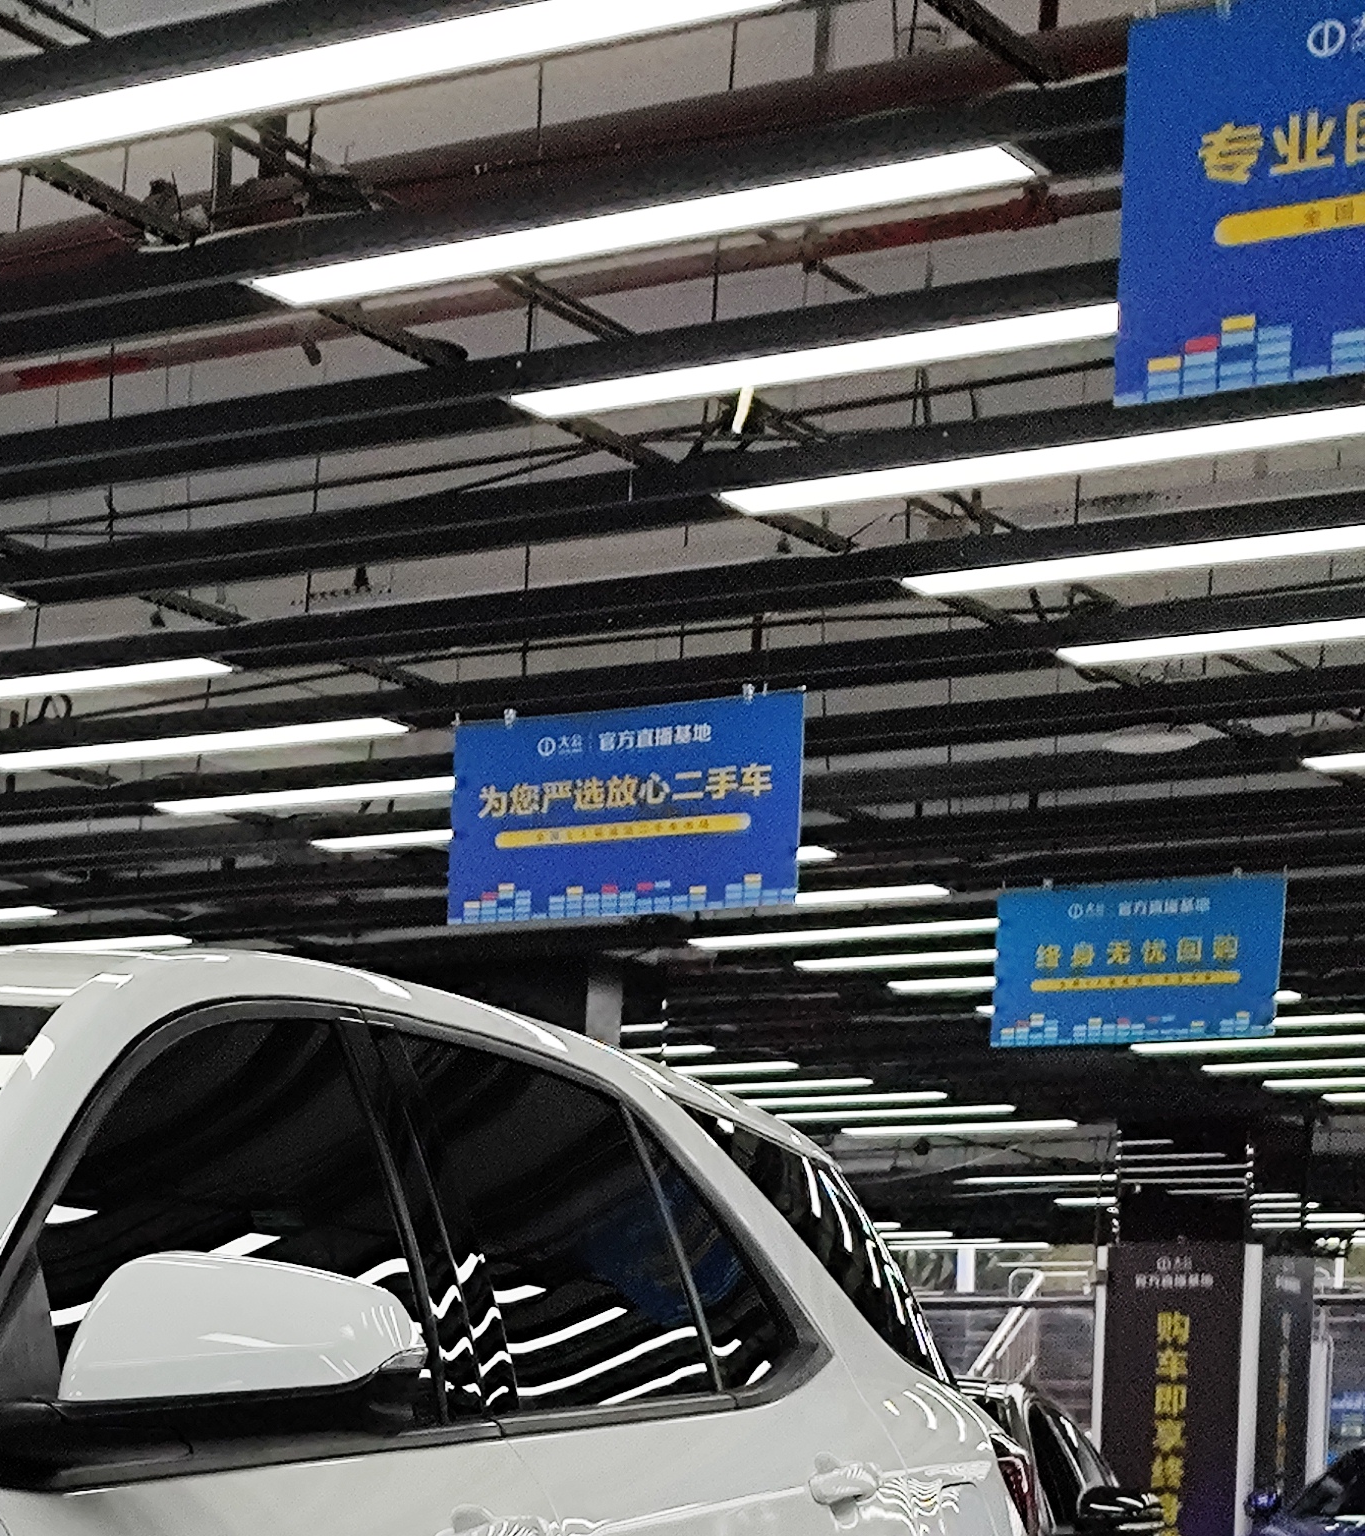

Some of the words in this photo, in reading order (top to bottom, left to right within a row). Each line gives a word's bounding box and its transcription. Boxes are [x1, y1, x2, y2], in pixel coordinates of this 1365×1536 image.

[599, 722, 712, 752] 官方直播基地
[478, 763, 773, 819] 为您严选放心二手车
